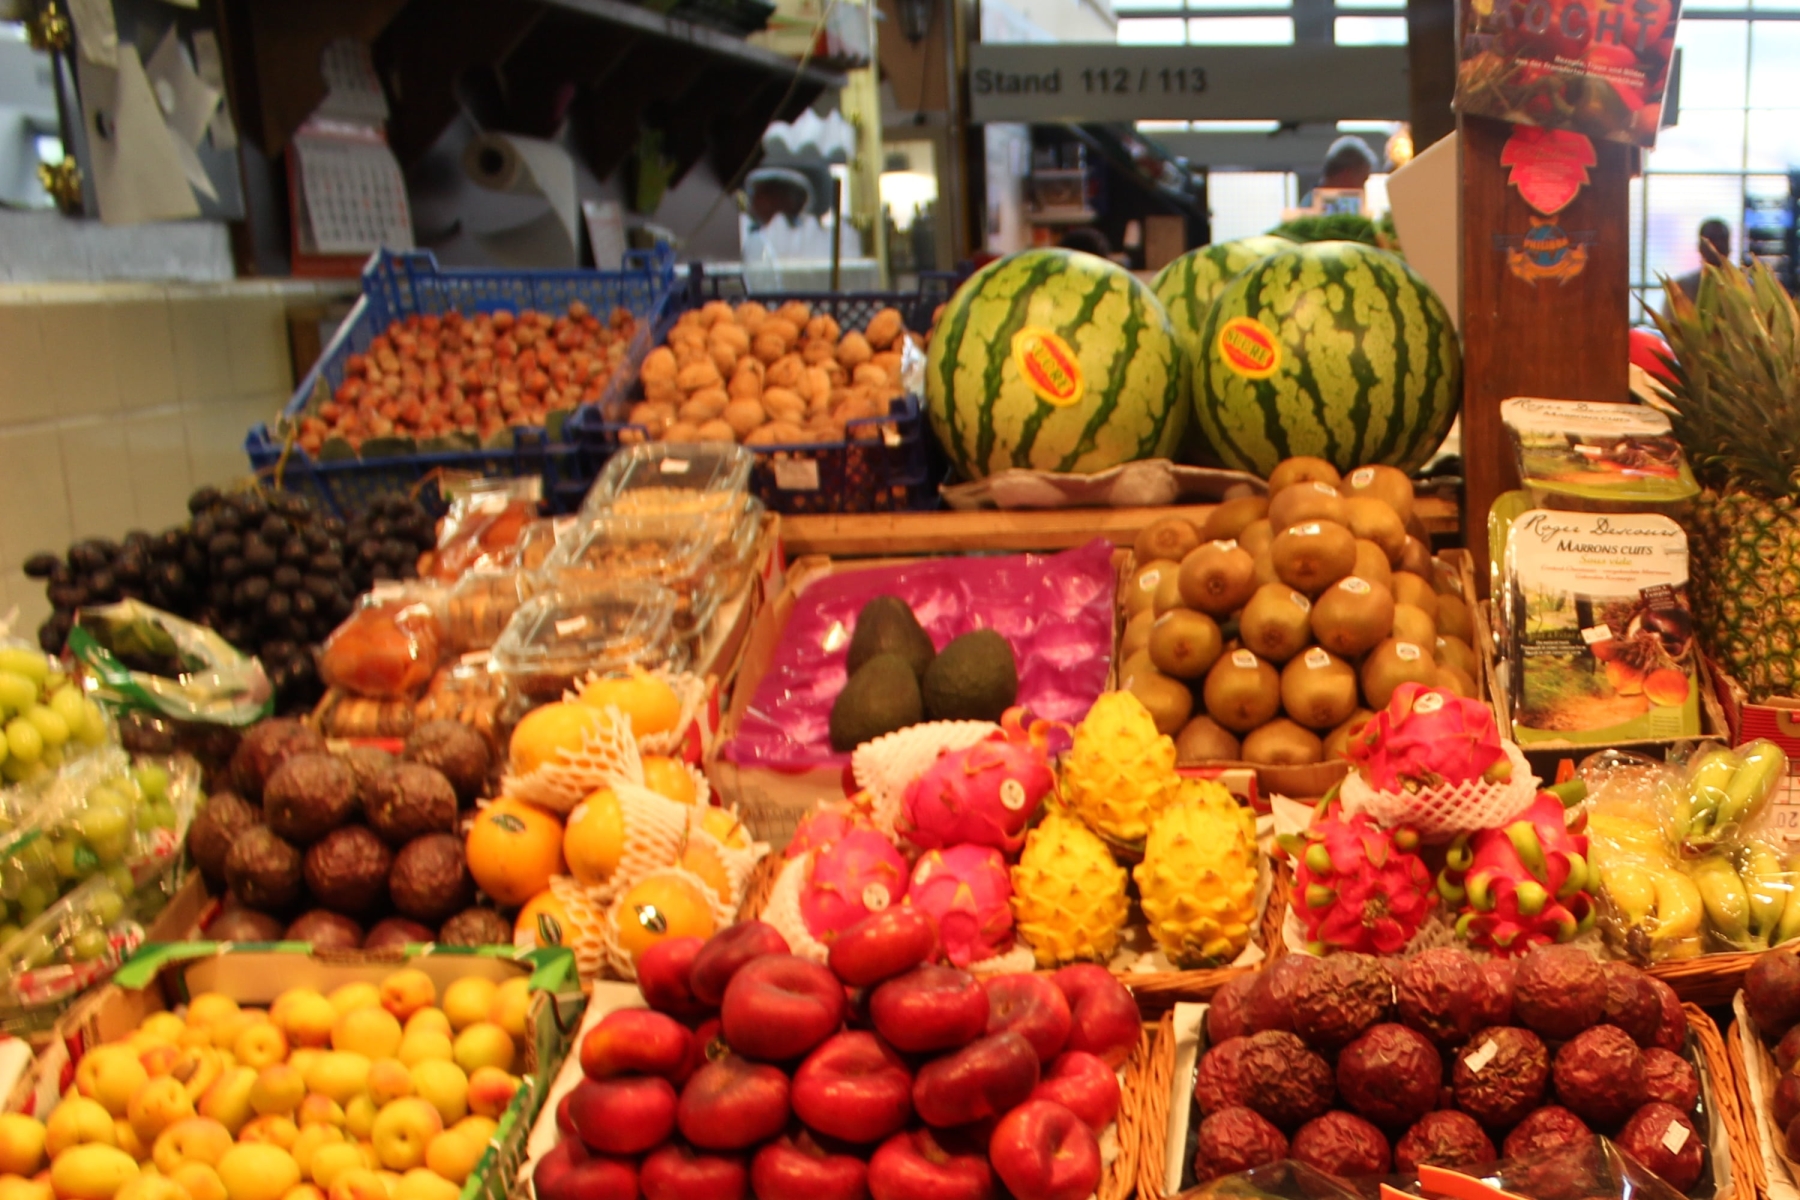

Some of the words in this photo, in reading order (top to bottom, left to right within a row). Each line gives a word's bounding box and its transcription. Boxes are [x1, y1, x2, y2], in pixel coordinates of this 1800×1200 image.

[975, 67, 1061, 94] Stand
[1081, 68, 1128, 94] 112
[1159, 68, 1209, 94] 113
